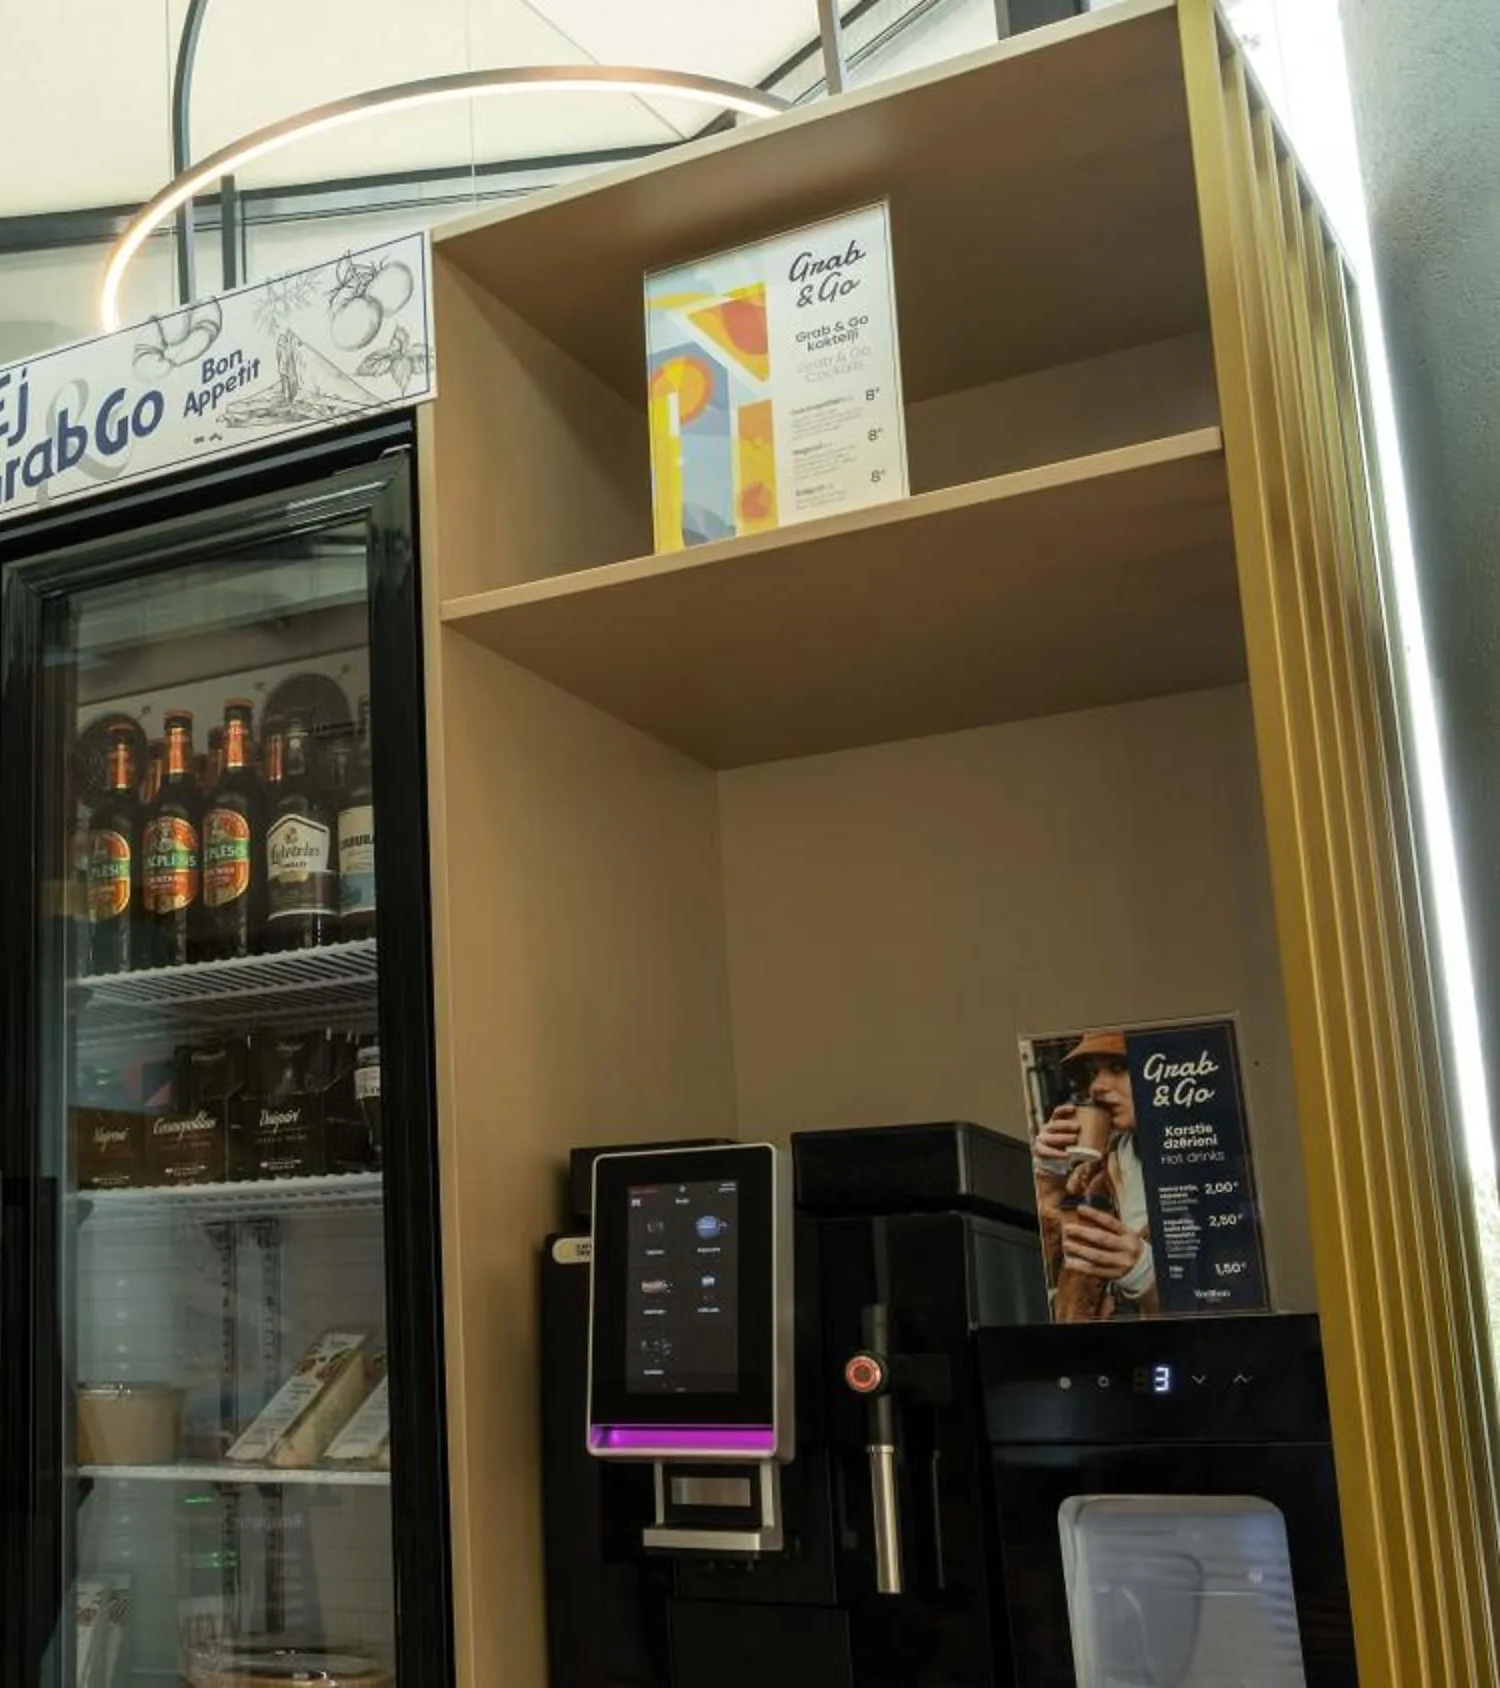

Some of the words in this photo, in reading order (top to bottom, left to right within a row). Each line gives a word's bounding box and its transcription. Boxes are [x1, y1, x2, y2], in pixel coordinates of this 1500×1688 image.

[789, 240, 867, 282] Grab
[796, 285, 814, 308] &
[818, 271, 861, 303] Go
[796, 325, 831, 343] Grab
[847, 314, 869, 328] Go
[202, 349, 243, 385] Bon
[183, 358, 261, 418] Appetit
[95, 387, 165, 456] Go
[1143, 1050, 1219, 1082] Grab
[1153, 1086, 1171, 1107] &
[1174, 1078, 1215, 1108] Go
[1154, 1366, 1170, 1393] 3
